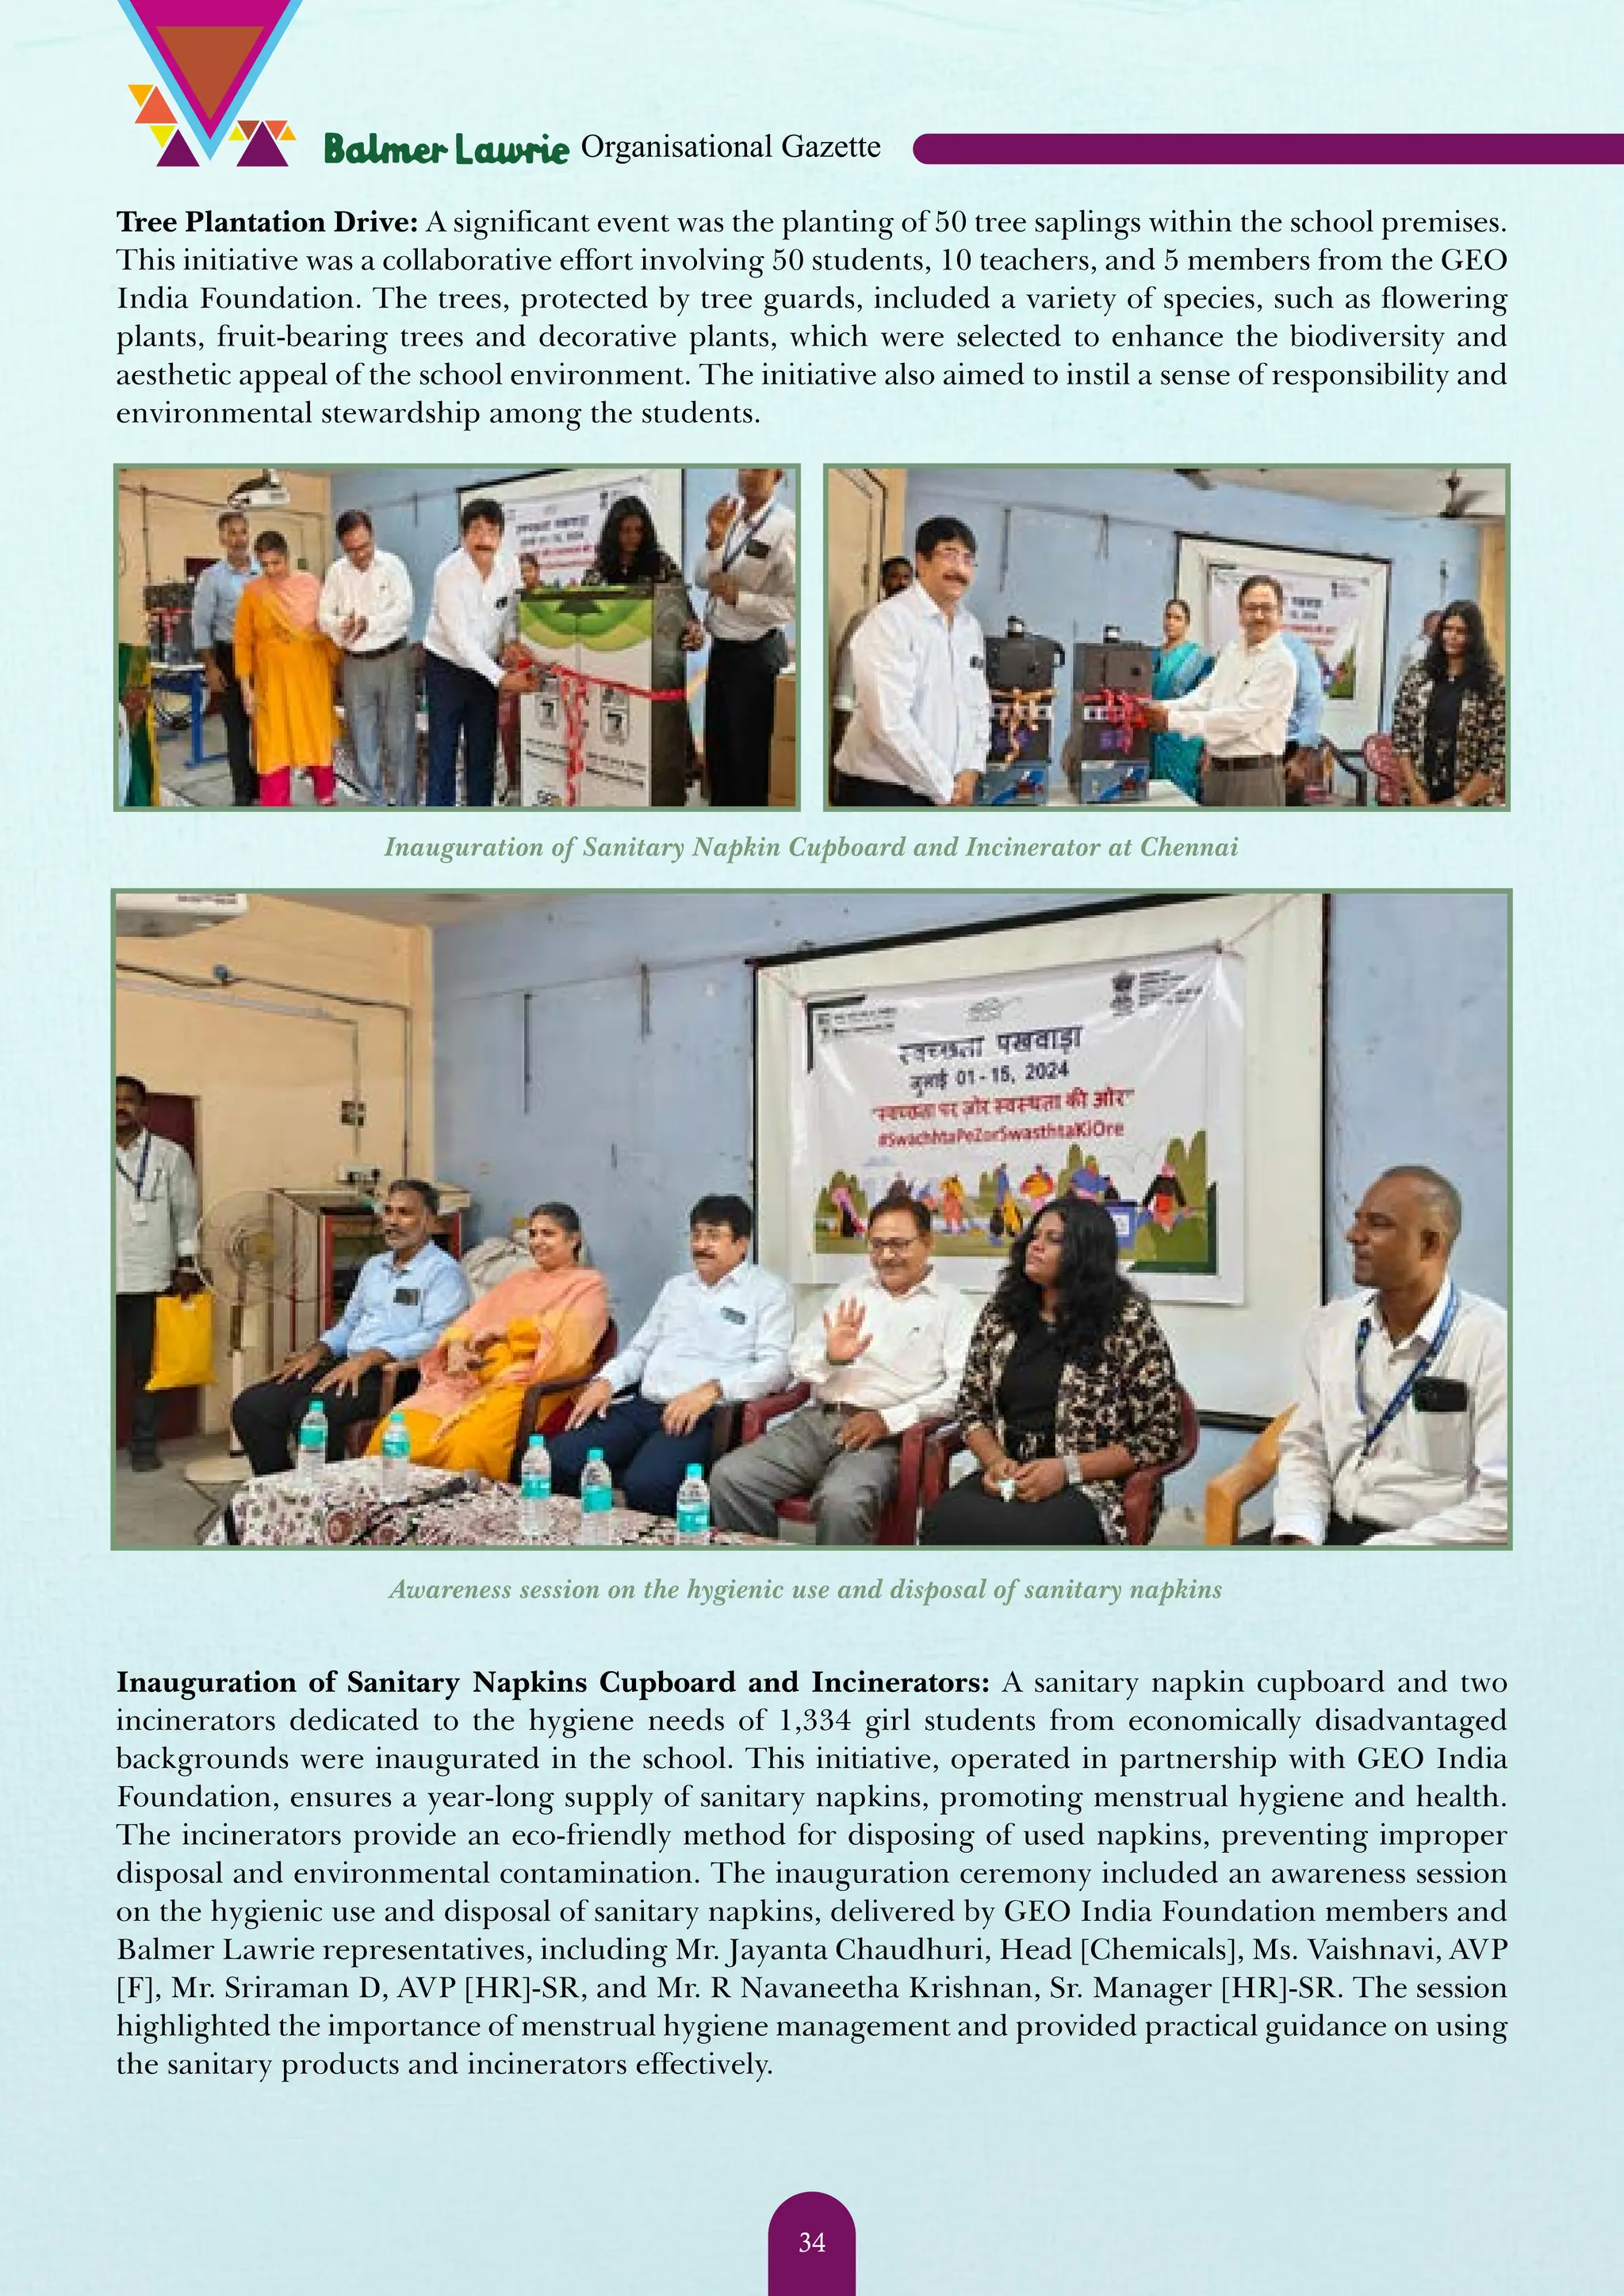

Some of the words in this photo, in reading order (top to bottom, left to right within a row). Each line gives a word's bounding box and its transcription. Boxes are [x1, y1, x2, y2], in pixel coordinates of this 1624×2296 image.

[325, 132, 448, 163] Balmer
[456, 133, 569, 164] Lawrie
[582, 134, 772, 164] Organisational
[783, 134, 880, 157] Gazette
[117, 211, 177, 232] Tree
[186, 210, 326, 232] Plantation
[334, 210, 416, 232] Drive:
[425, 211, 447, 232] A
[454, 210, 590, 239] significant
[598, 215, 669, 232] event
[677, 218, 723, 232] was
[733, 209, 773, 232] the
[783, 210, 894, 240] planting
[902, 210, 930, 232] of
[936, 211, 966, 232] 50
[975, 215, 1026, 232] tree
[1036, 210, 1140, 240] saplings
[1149, 209, 1231, 232] within
[1241, 209, 1281, 232] the
[1291, 210, 1373, 232] school
[1382, 210, 1506, 240] premises.
[117, 248, 174, 270] This
[184, 248, 297, 270] initiative
[306, 256, 352, 270] was
[362, 256, 375, 270] a
[383, 248, 551, 270] collaborative
[561, 248, 633, 270] effort
[641, 248, 764, 278] involving
[773, 249, 803, 270] 50
[813, 248, 930, 274] students,
[944, 249, 971, 270] 10
[980, 248, 1096, 274] teachers,
[1106, 248, 1155, 270] and
[1165, 249, 1178, 270] 5
[1188, 248, 1309, 270] members
[1319, 248, 1382, 270] from
[1392, 248, 1432, 270] the
[1442, 249, 1507, 270] GEO
[117, 324, 204, 354] plants,
[218, 324, 388, 354] fruit-bearing
[400, 330, 463, 346] trees
[477, 324, 526, 346] and
[539, 324, 676, 346] decorative
[690, 324, 776, 354] plants,
[790, 324, 868, 346] which
[881, 332, 944, 346] were
[958, 324, 1061, 346] selected
[1074, 330, 1099, 346] to
[1113, 324, 1223, 346] enhance
[1237, 324, 1277, 346] the
[1290, 324, 1445, 354] biodiversity
[1457, 324, 1507, 346] and
[117, 401, 312, 423] environmental
[322, 400, 480, 430] stewardship
[490, 408, 581, 430] among
[592, 401, 632, 423] the
[642, 400, 759, 423] students.
[384, 837, 543, 863] Inauguration
[552, 836, 578, 863] of
[584, 837, 684, 863] Sanitary
[692, 836, 779, 863] Napkin
[790, 836, 906, 863] Cupboard
[914, 836, 959, 856] and
[965, 837, 1101, 856] Incinerator
[1109, 840, 1132, 856] at
[1141, 836, 1238, 856] Chennai
[956, 1070, 975, 1087] 01
[1025, 1060, 1070, 1081] 2024
[1066, 1087, 1088, 1108] की
[388, 1579, 511, 1598] Awareness
[519, 1579, 599, 1598] session
[608, 1586, 635, 1598] on
[645, 1578, 679, 1598] the
[688, 1578, 783, 1605] hygienic
[792, 1586, 829, 1598] use
[838, 1578, 883, 1598] and
[891, 1578, 986, 1605] disposal
[994, 1578, 1020, 1605] of
[1025, 1579, 1121, 1605] sanitary
[1130, 1578, 1222, 1605] napkins
[117, 1670, 297, 1700] Inauguration
[309, 1670, 338, 1692] of
[348, 1670, 460, 1700] Sanitary
[473, 1670, 587, 1700] Napkins
[600, 1670, 736, 1700] Cupboard
[749, 1670, 799, 1692] and
[812, 1670, 988, 1692] Incinerators:
[1002, 1671, 1023, 1692] A
[1035, 1670, 1139, 1700] sanitary
[1152, 1670, 1244, 1700] napkin
[1258, 1670, 1385, 1700] cupboard
[1398, 1670, 1447, 1692] and
[1461, 1675, 1507, 1692] two
[117, 1709, 275, 1731] incinerators
[290, 1709, 419, 1731] dedicated
[434, 1713, 458, 1731] to
[473, 1709, 514, 1731] the
[530, 1709, 634, 1739] hygiene
[649, 1709, 724, 1731] needs
[739, 1709, 768, 1731] of
[782, 1709, 851, 1735] 1,334
[866, 1709, 910, 1739] girl
[925, 1709, 1035, 1731] students
[1050, 1709, 1114, 1731] from
[1129, 1709, 1301, 1739] economically
[1316, 1709, 1507, 1739] disadvantaged
[118, 1785, 278, 1811] Foundation,
[291, 1793, 391, 1807] ensures
[403, 1793, 416, 1807] a
[428, 1785, 554, 1815] year-long
[565, 1785, 653, 1815] supply
[665, 1785, 693, 1807] of
[701, 1785, 805, 1815] sanitary
[817, 1785, 928, 1815] napkins,
[940, 1785, 1083, 1815] promoting
[1094, 1785, 1228, 1807] menstrual
[1239, 1785, 1343, 1815] hygiene
[1355, 1785, 1404, 1807] and
[1417, 1785, 1506, 1807] health.
[117, 1938, 214, 1960] Balmer
[224, 1938, 314, 1960] Lawrie
[323, 1938, 531, 1968] representatives,
[541, 1938, 668, 1968] including
[676, 1938, 718, 1959] Mr.
[725, 1938, 828, 1968] Jayanta
[837, 1938, 990, 1964] Chaudhuri,
[1001, 1938, 1072, 1960] Head
[1082, 1938, 1243, 1965] [Chemicals],
[1253, 1938, 1297, 1960] Ms.
[1308, 1938, 1441, 1964] Vaishnavi,
[1449, 1938, 1507, 1960] AVP
[117, 2052, 158, 2074] the
[168, 2052, 272, 2082] sanitary
[282, 2052, 399, 2082] products
[409, 2052, 458, 2074] and
[469, 2052, 626, 2074] incinerators
[637, 2052, 772, 2082] effectively.
[799, 2232, 826, 2252] 34
